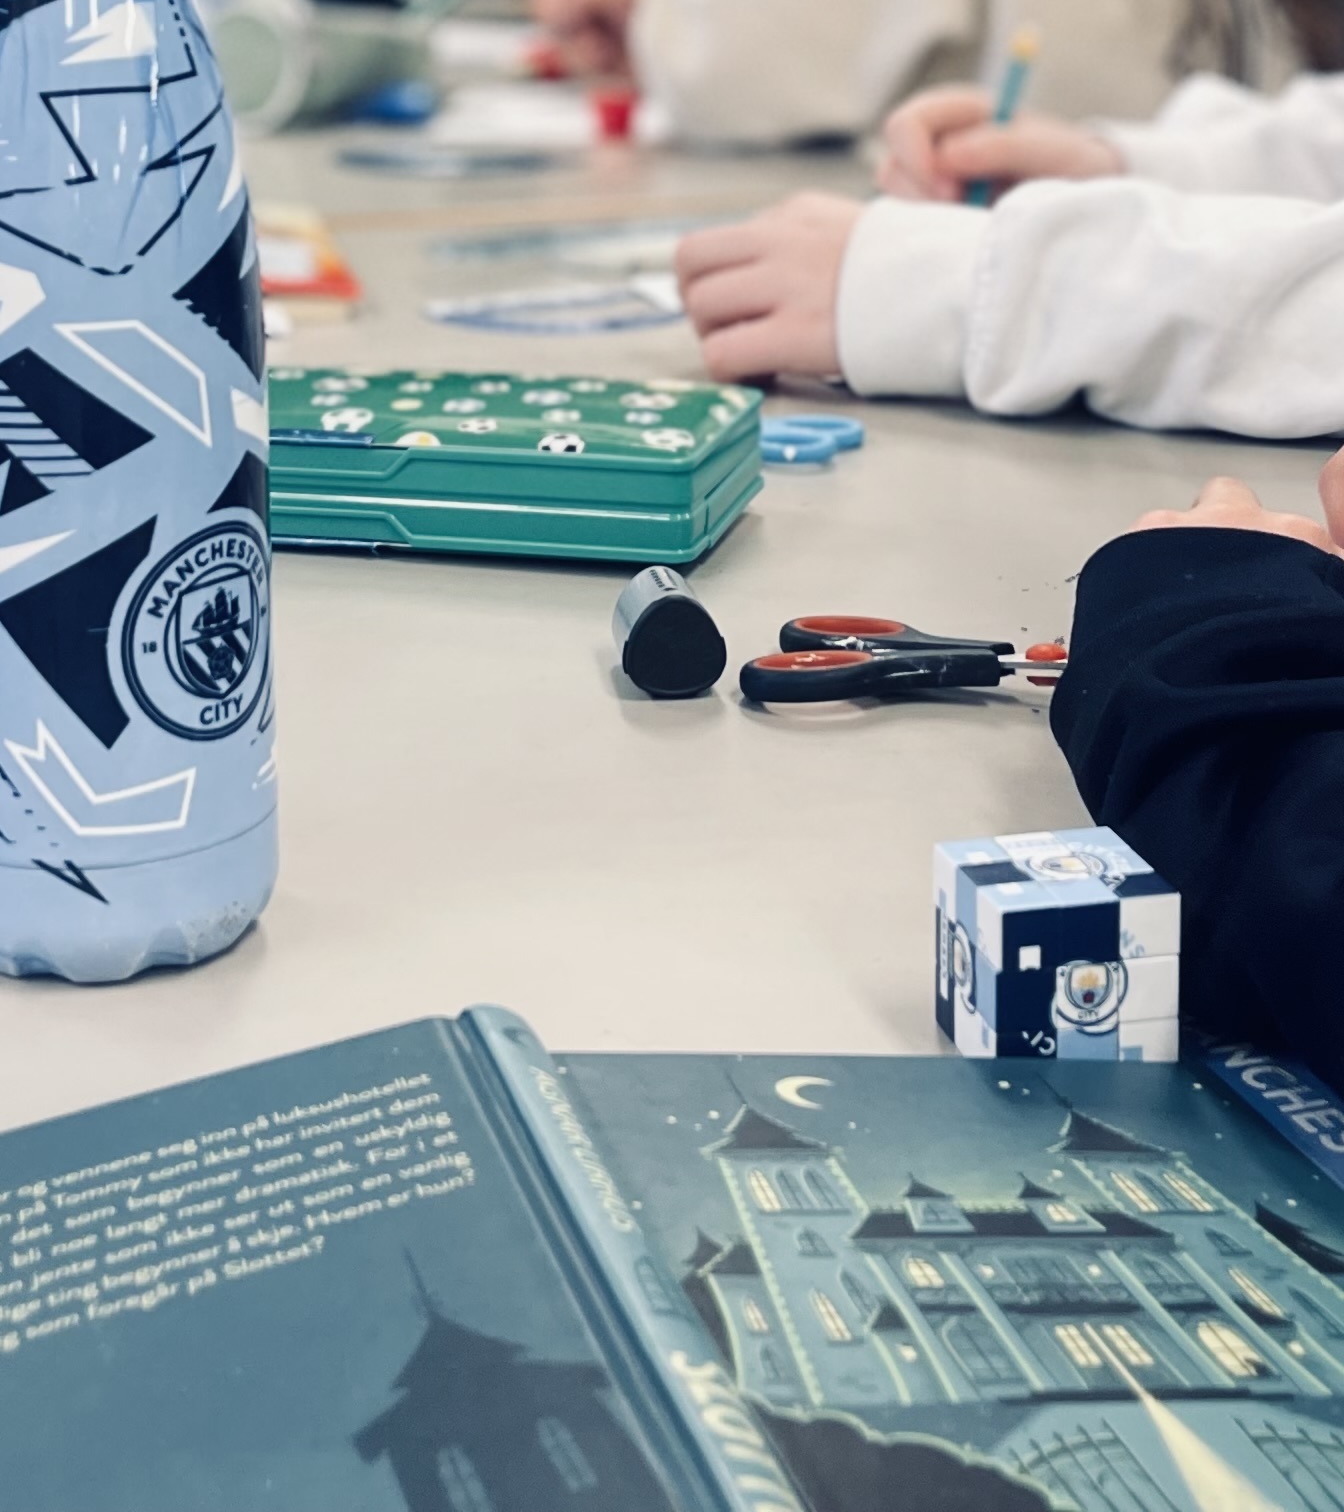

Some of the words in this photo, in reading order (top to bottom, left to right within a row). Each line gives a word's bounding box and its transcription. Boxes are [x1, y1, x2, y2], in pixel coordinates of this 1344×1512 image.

[146, 538, 264, 619] MANCHESTER
[141, 641, 158, 654] 18
[199, 693, 244, 726] CITY
[12, 1223, 52, 1243] det
[65, 1206, 116, 1228] som
[128, 1170, 241, 1209] begynner
[253, 1152, 303, 1173] som
[313, 1141, 343, 1157] en
[355, 1111, 451, 1145] uskyldig
[17, 1180, 48, 1198] og
[52, 1151, 152, 1186] vennene
[158, 1138, 198, 1157] seg
[203, 1127, 236, 1144] inn
[242, 1114, 269, 1137] på
[273, 1073, 432, 1124] luksushotellet
[17, 1195, 46, 1223] på
[52, 1176, 142, 1207] Tommy
[148, 1160, 198, 1180] som
[205, 1145, 250, 1165] ikke
[256, 1133, 293, 1150] har
[299, 1107, 383, 1138] invitert
[389, 1092, 441, 1112] dem
[367, 1145, 409, 1164] For
[433, 1131, 457, 1147] et
[31, 1259, 96, 1290] jente
[106, 1241, 157, 1263] som
[166, 1223, 215, 1245] ikke
[224, 1211, 260, 1228] ser
[269, 1199, 294, 1216] ut
[304, 1184, 353, 1205] som
[361, 1173, 391, 1189] en
[399, 1151, 471, 1178] vanlig
[103, 1246, 222, 1288] begynner
[305, 1199, 382, 1229] Hvem
[388, 1190, 413, 1207] er
[27, 1313, 79, 1339] som
[87, 1283, 181, 1320] foregår
[189, 1268, 216, 1295] på
[223, 1235, 324, 1277] Slottet?
